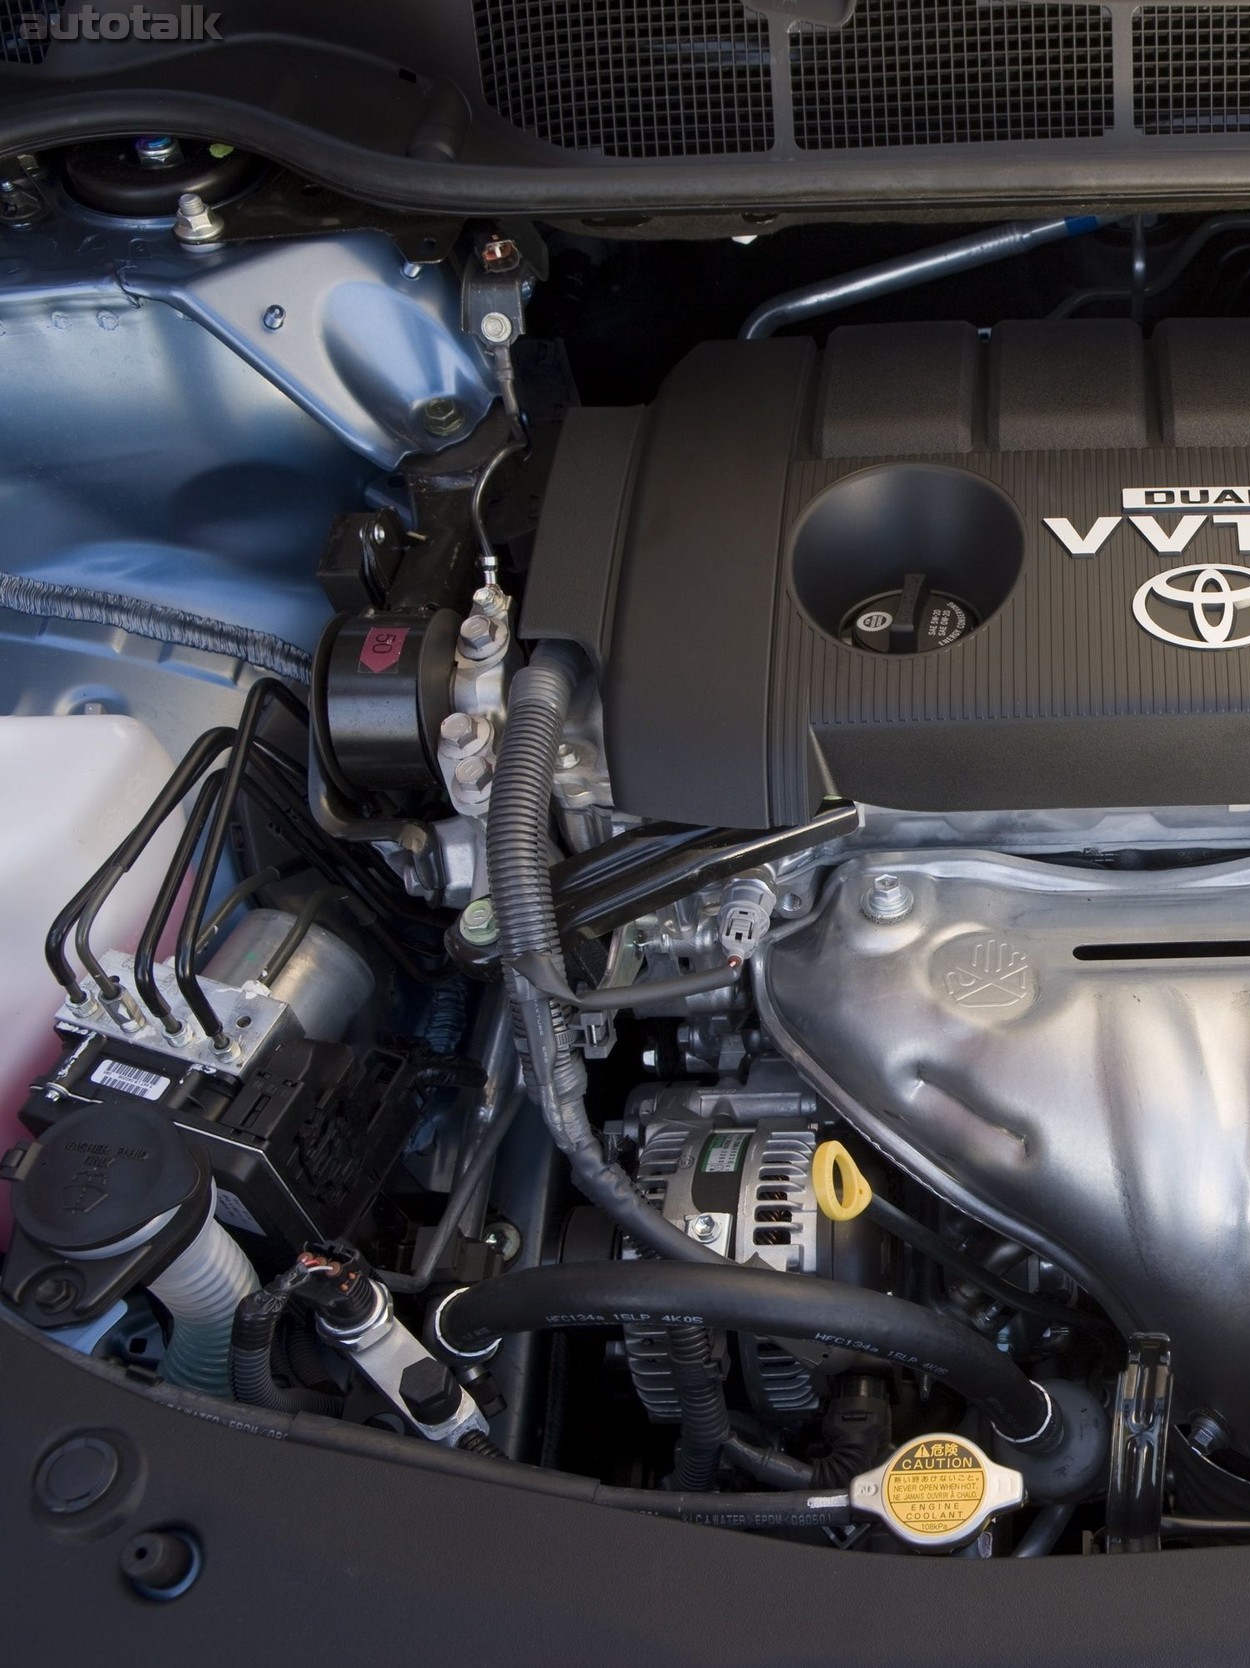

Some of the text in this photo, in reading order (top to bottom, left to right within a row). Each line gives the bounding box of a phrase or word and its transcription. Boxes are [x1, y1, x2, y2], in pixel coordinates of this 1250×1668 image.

[372, 634, 396, 654] 50
[931, 1443, 958, 1457] 危険
[902, 1456, 973, 1470] CAUTION
[894, 1484, 917, 1493] NEVER
[919, 1483, 938, 1491] OPEN
[939, 1483, 961, 1491] WHEN
[903, 1492, 924, 1500] JAMAIS
[927, 1491, 948, 1499] OUVRIR
[911, 1503, 960, 1511] ENGINE
[906, 1511, 963, 1520] COOLANT
[921, 1522, 948, 1531] 108kPa
